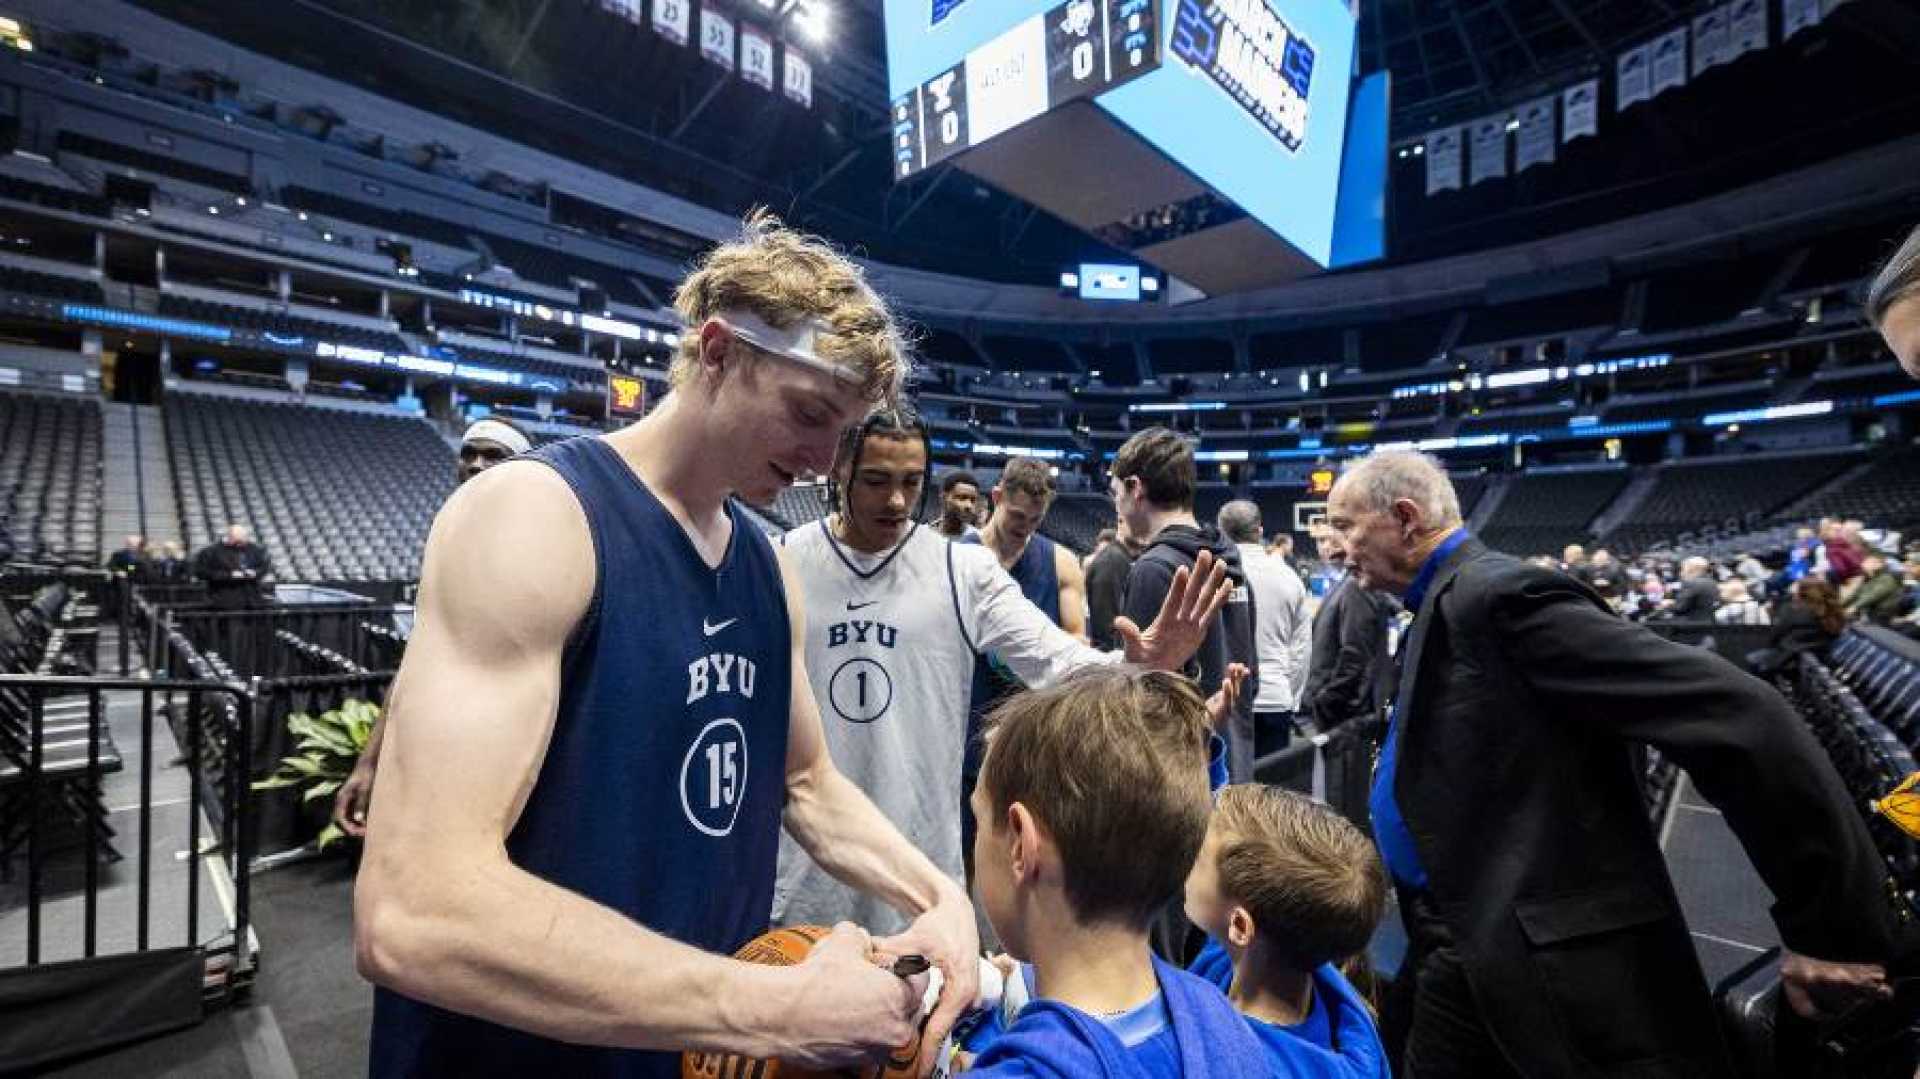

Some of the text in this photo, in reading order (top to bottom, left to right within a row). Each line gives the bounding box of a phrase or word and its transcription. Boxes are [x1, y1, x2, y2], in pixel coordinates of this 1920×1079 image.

[1073, 42, 1093, 80] 0
[942, 111, 959, 144] 0
[827, 620, 898, 648] BYU
[686, 653, 756, 705] BYU
[856, 671, 868, 708] 1
[705, 741, 737, 809] 15
